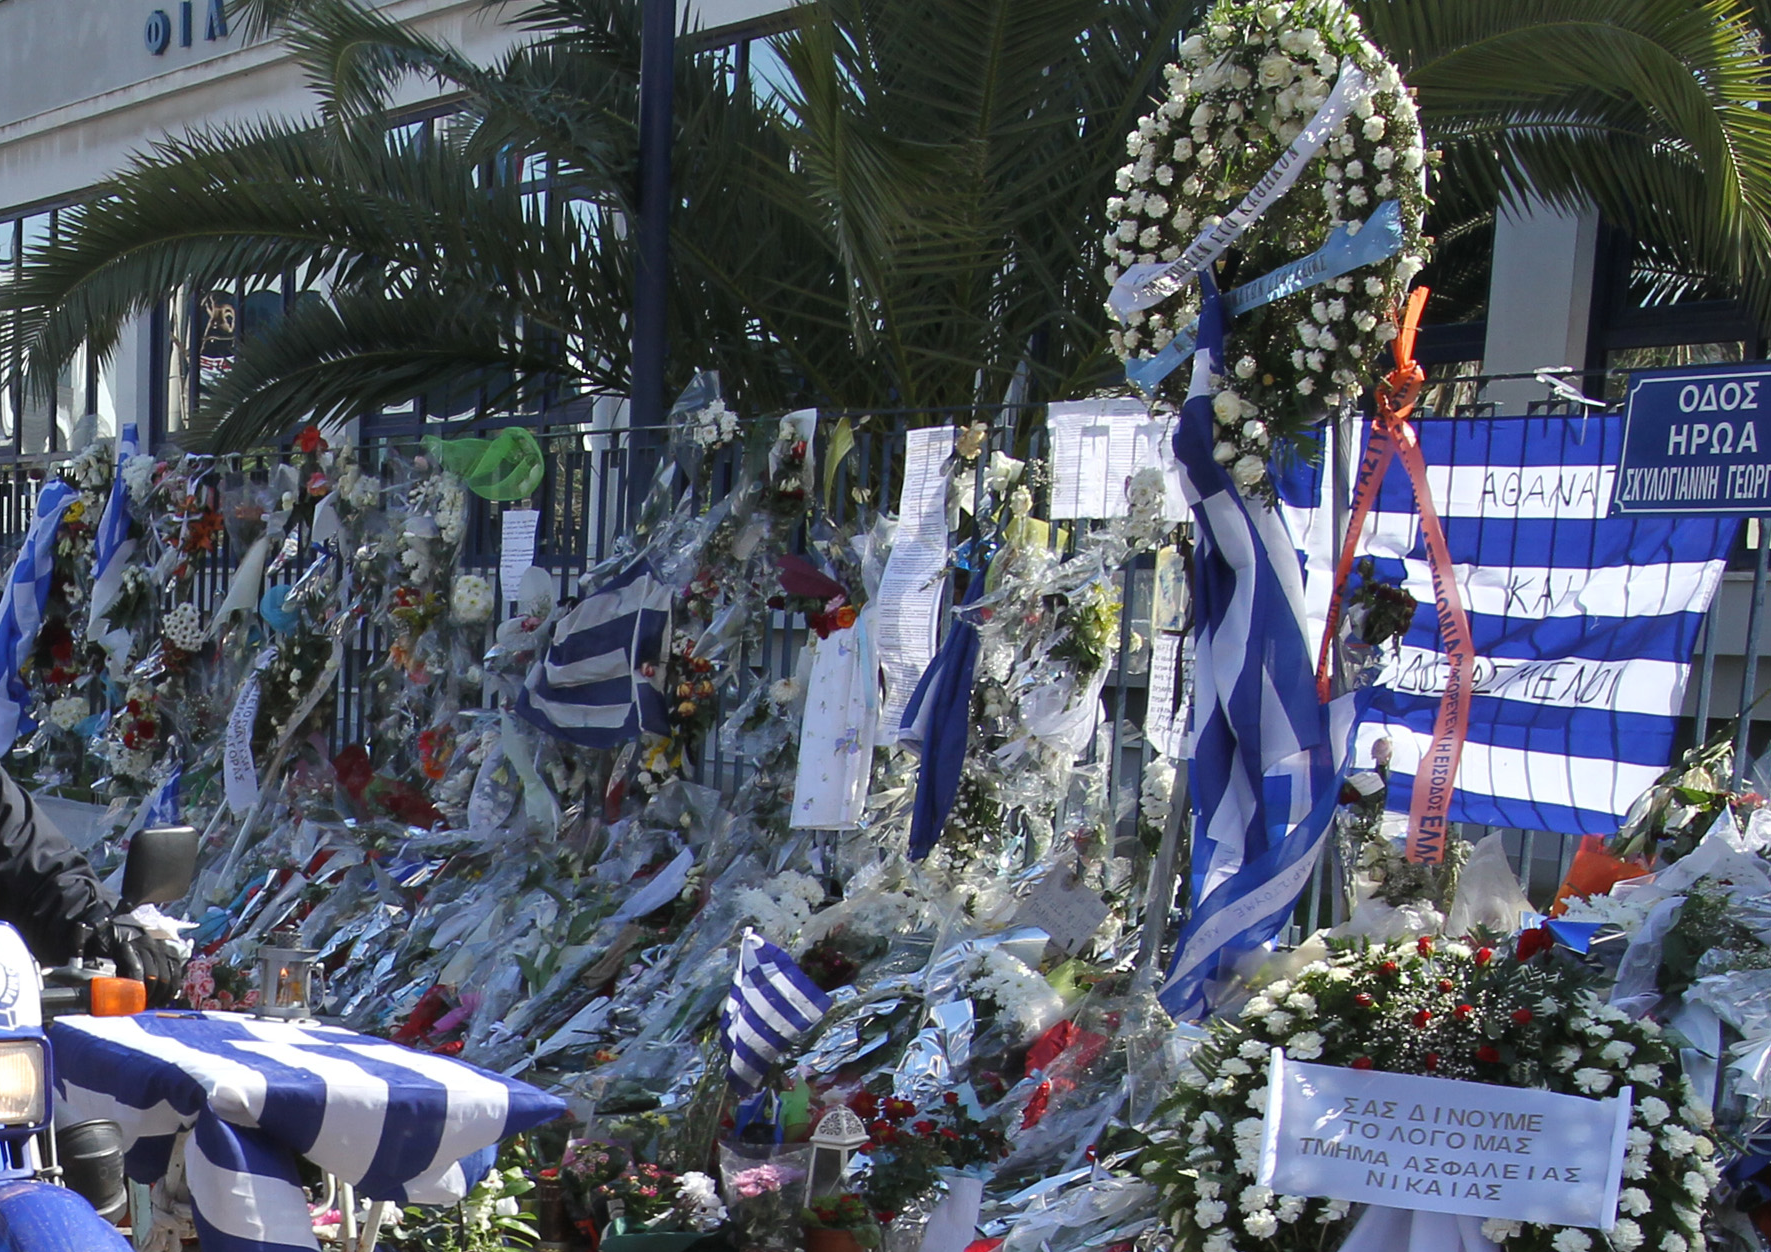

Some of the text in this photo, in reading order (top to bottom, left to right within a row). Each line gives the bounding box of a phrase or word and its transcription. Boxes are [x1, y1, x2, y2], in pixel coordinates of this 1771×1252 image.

[1209, 217, 1239, 245] ΣΤΟ
[1236, 145, 1300, 217] ΚΑΘΗΚΟΝ
[1679, 381, 1760, 413] ΟΔΟΣ
[1667, 421, 1758, 456] ΗΡΩΑ
[1480, 470, 1616, 509] ΑΘΑΝΑ
[1622, 465, 1720, 501] ΣΚΥΛΟΓΙΑΝΝΗ
[1507, 574, 1574, 616] ΚΑΙ
[1427, 756, 1451, 811] ΕΙΣΟΔΟΣ
[1342, 1096, 1544, 1133] ΣΑΣ ΔΙΝΟΥΜΕ
[1343, 1118, 1533, 1156] ΤΟ ΛΟΓΟ ΜΑΣ
[1299, 1137, 1582, 1184] ΤΜΗΜΑ ΑΣΦΑΛΕΙΑΣ
[1365, 1169, 1503, 1201] ΝΙΚΑΙΑΣ
